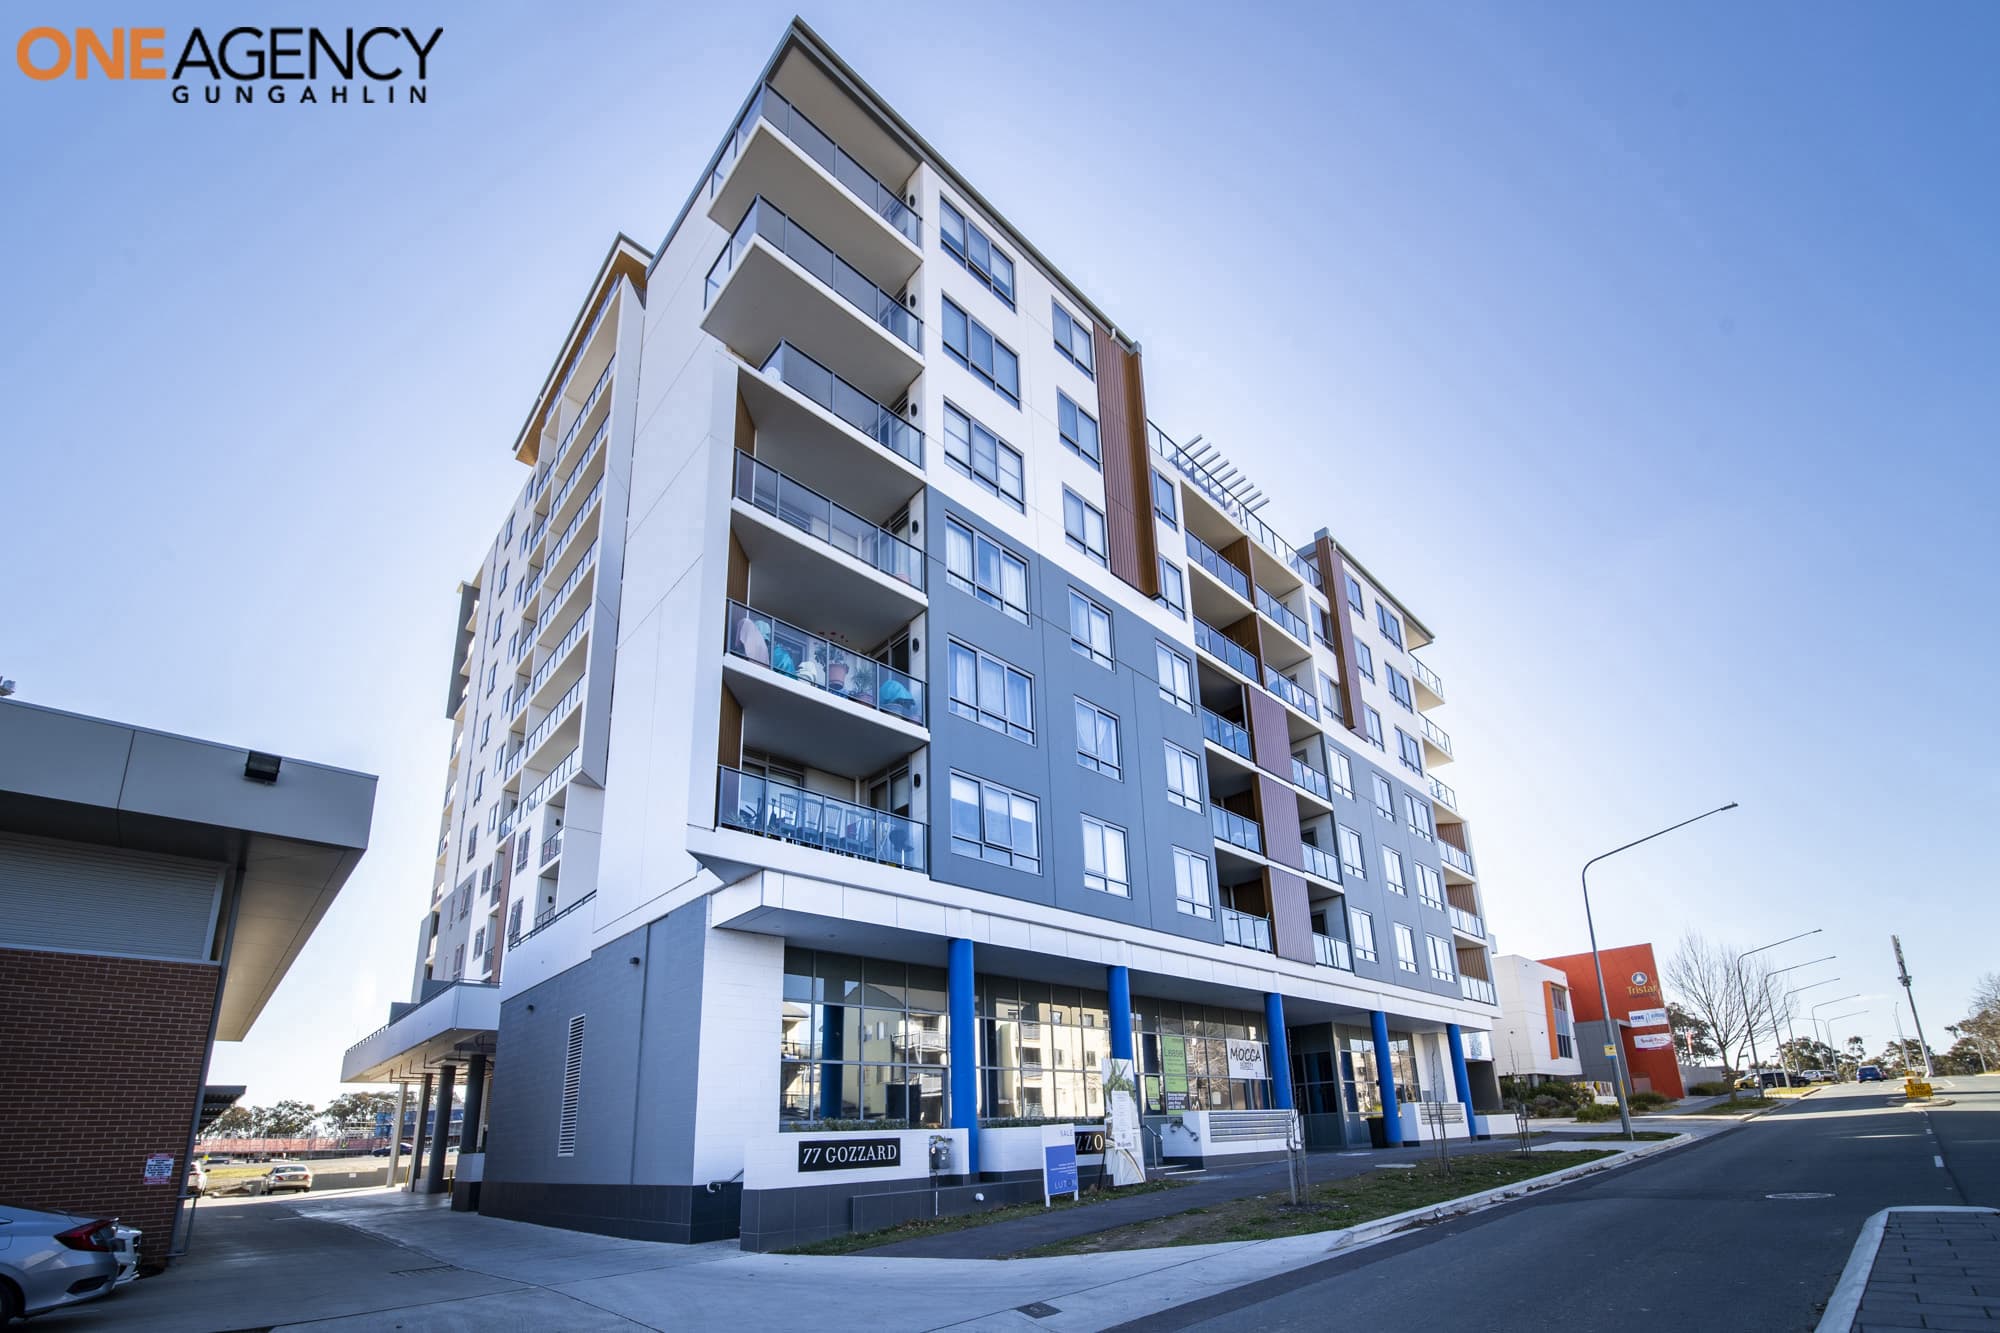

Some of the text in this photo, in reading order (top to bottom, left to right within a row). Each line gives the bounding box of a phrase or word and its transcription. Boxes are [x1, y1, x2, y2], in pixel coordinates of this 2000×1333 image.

[1230, 1047, 1261, 1062] MOCCA
[803, 1144, 897, 1164] 77 GOZZARD
